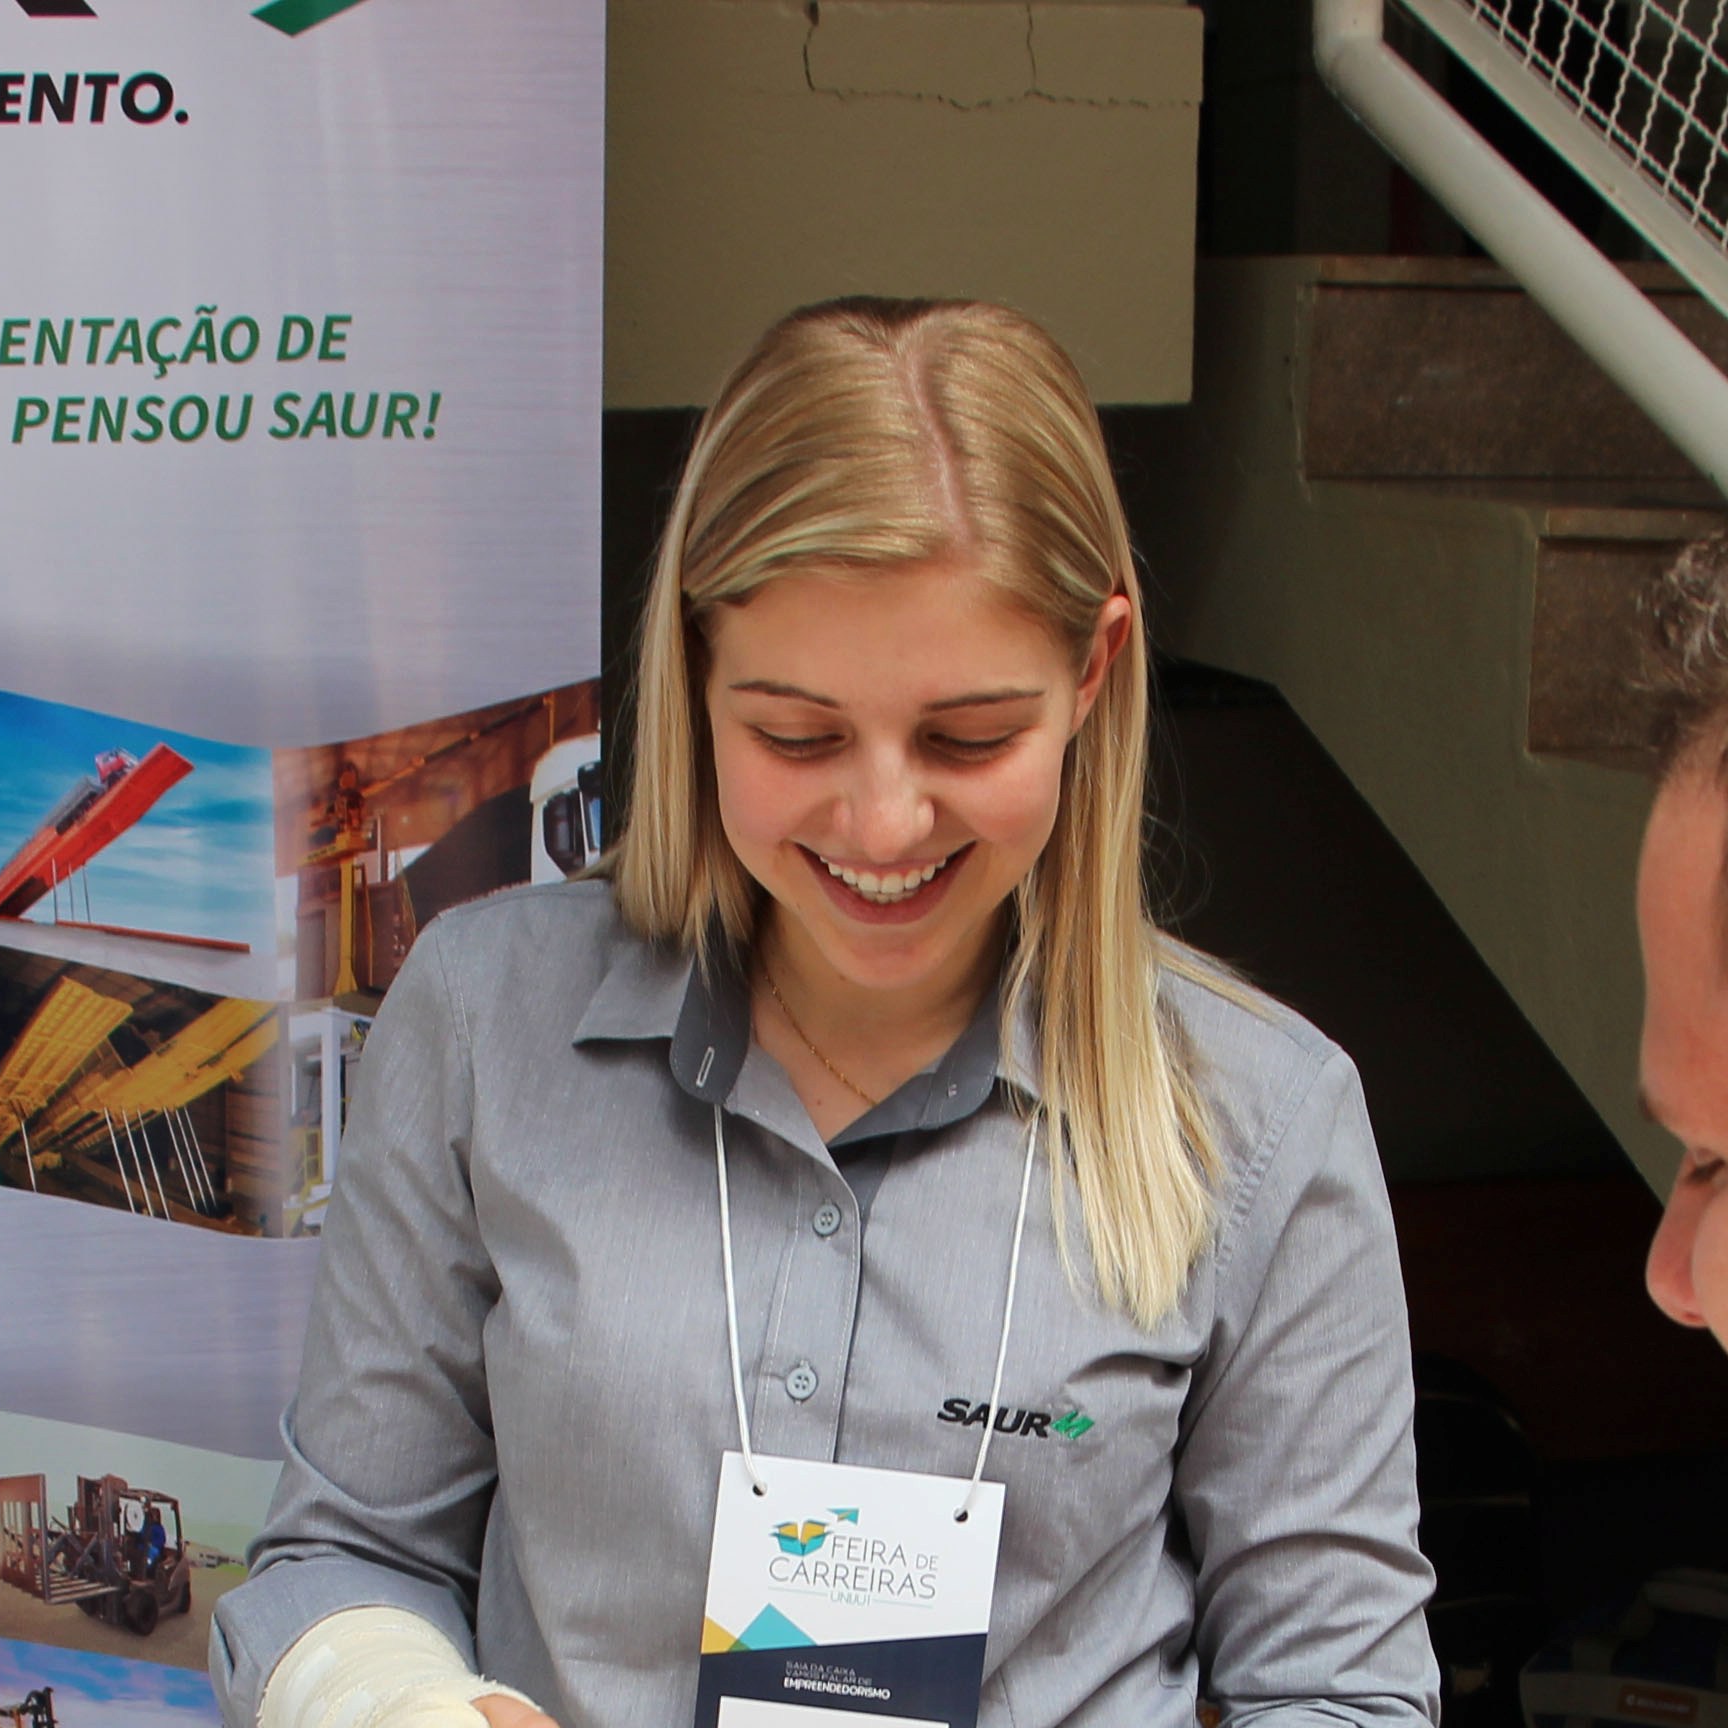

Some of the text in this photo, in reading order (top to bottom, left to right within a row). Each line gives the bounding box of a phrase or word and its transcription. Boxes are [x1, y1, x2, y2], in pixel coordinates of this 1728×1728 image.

[275, 314, 351, 364] DE
[11, 393, 253, 446] PENSOU
[266, 390, 443, 442] SAUR!
[936, 1397, 1052, 1439] SAUR
[830, 1534, 940, 1572] FEIRA DE
[768, 1555, 937, 1600] CARREIRAS
[783, 1676, 892, 1701] EMPREENDEDORISMO
